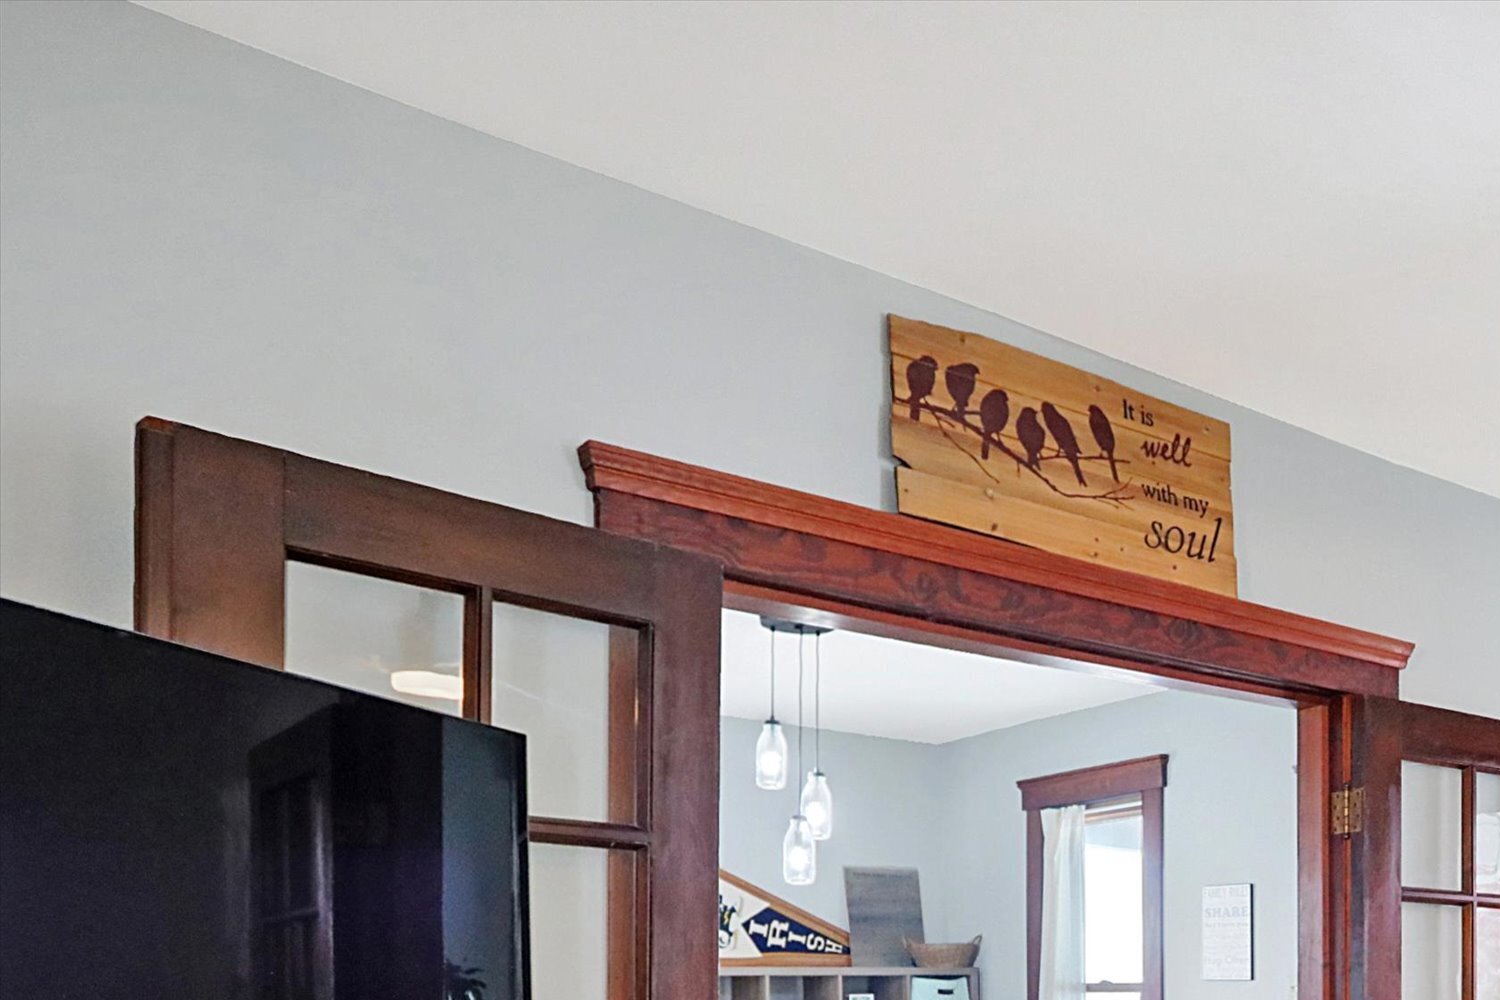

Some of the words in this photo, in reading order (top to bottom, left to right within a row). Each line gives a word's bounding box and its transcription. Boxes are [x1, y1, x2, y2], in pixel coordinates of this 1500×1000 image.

[1122, 398, 1135, 421] It
[1141, 405, 1154, 427] is
[1140, 432, 1192, 468] well
[1142, 482, 1178, 507] with
[1184, 495, 1209, 518] my
[1144, 516, 1223, 563] soul
[748, 919, 843, 954] IRISH
